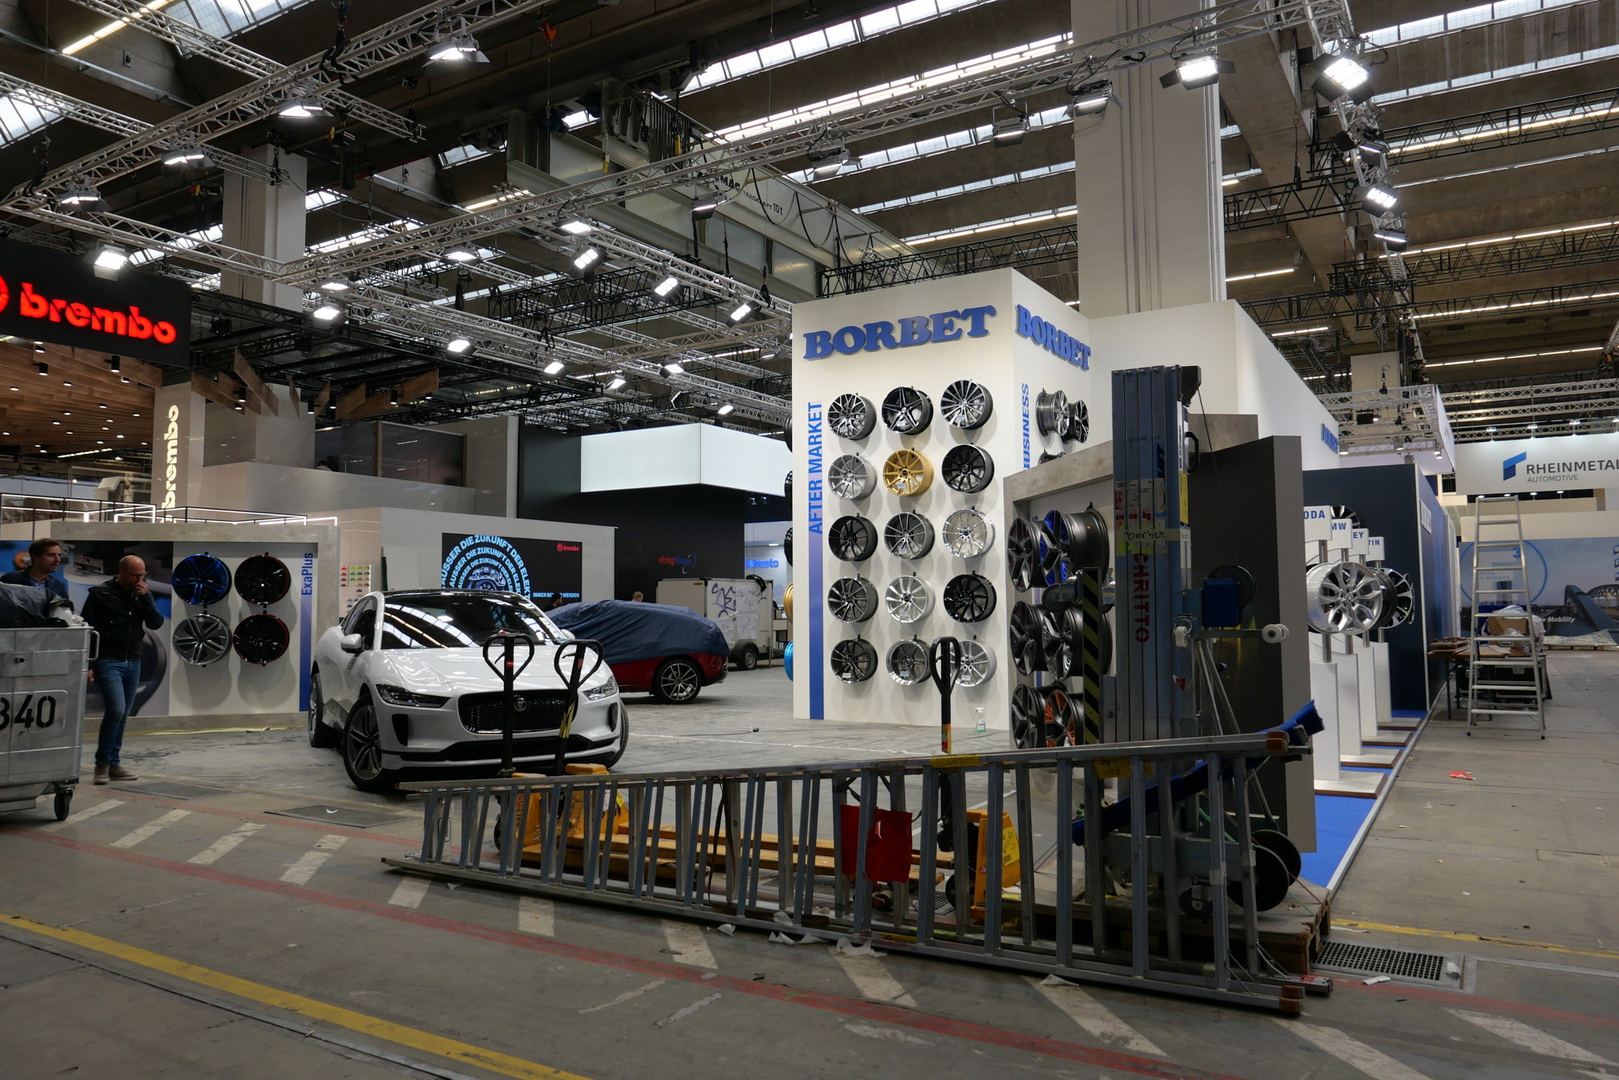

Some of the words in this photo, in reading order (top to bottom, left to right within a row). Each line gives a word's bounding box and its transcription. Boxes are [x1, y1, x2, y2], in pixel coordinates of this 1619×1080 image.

[20, 282, 177, 344] brembo
[803, 304, 996, 360] BORBET
[1016, 303, 1091, 370] BORBET
[161, 405, 179, 508] brembo
[808, 402, 823, 473] MARKET
[1526, 459, 1619, 475] RHEINMETAL
[1527, 474, 1578, 483] AUTOMOTIVE
[808, 479, 823, 534] AFTER
[460, 536, 475, 550] DIE
[474, 535, 512, 551] ZUKUNFT
[510, 549, 525, 569] DER
[465, 550, 477, 560] DIE
[476, 547, 507, 561] ZUKUNFT
[1512, 547, 1521, 559] 3
[301, 553, 313, 595] ExaPlus
[1547, 616, 1576, 624] Mobility
